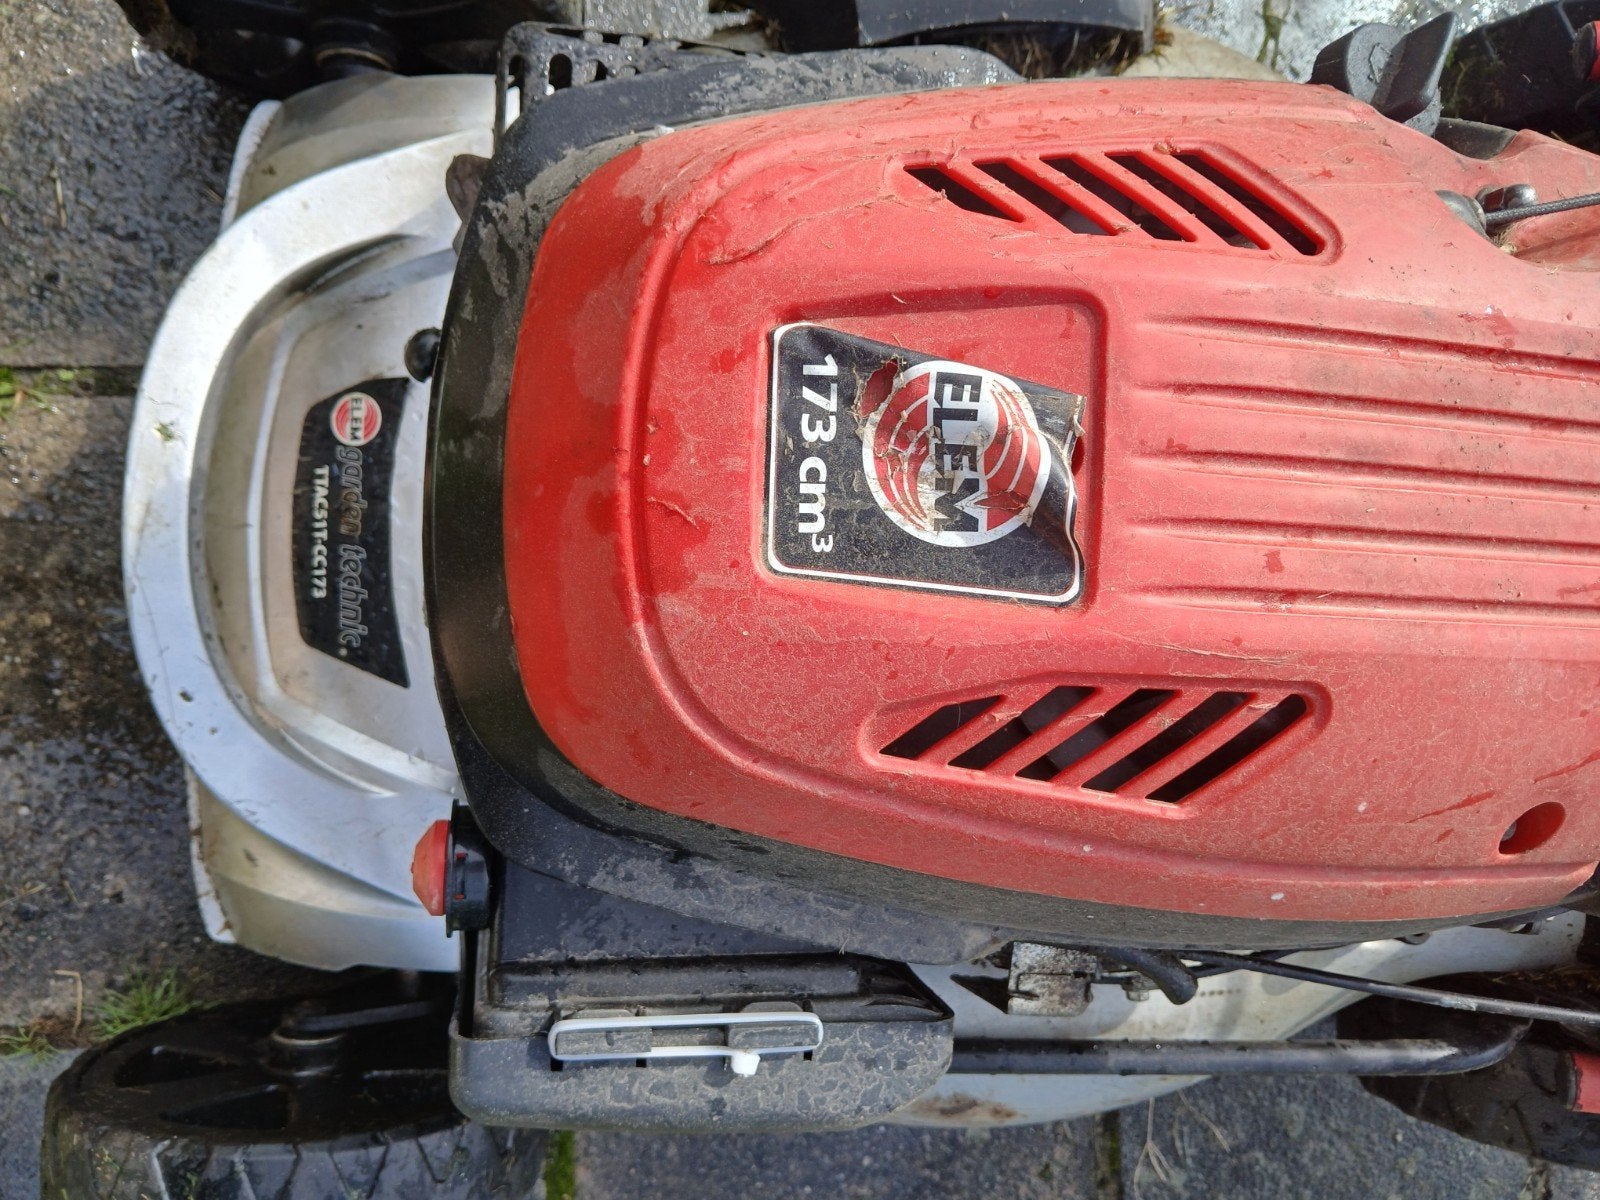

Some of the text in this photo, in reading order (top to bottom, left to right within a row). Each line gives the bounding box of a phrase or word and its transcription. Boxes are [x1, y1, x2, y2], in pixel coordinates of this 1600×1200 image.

[349, 398, 362, 440] ELEM
[801, 354, 839, 443] 173
[336, 445, 368, 535] garden
[934, 371, 983, 532] ELEM
